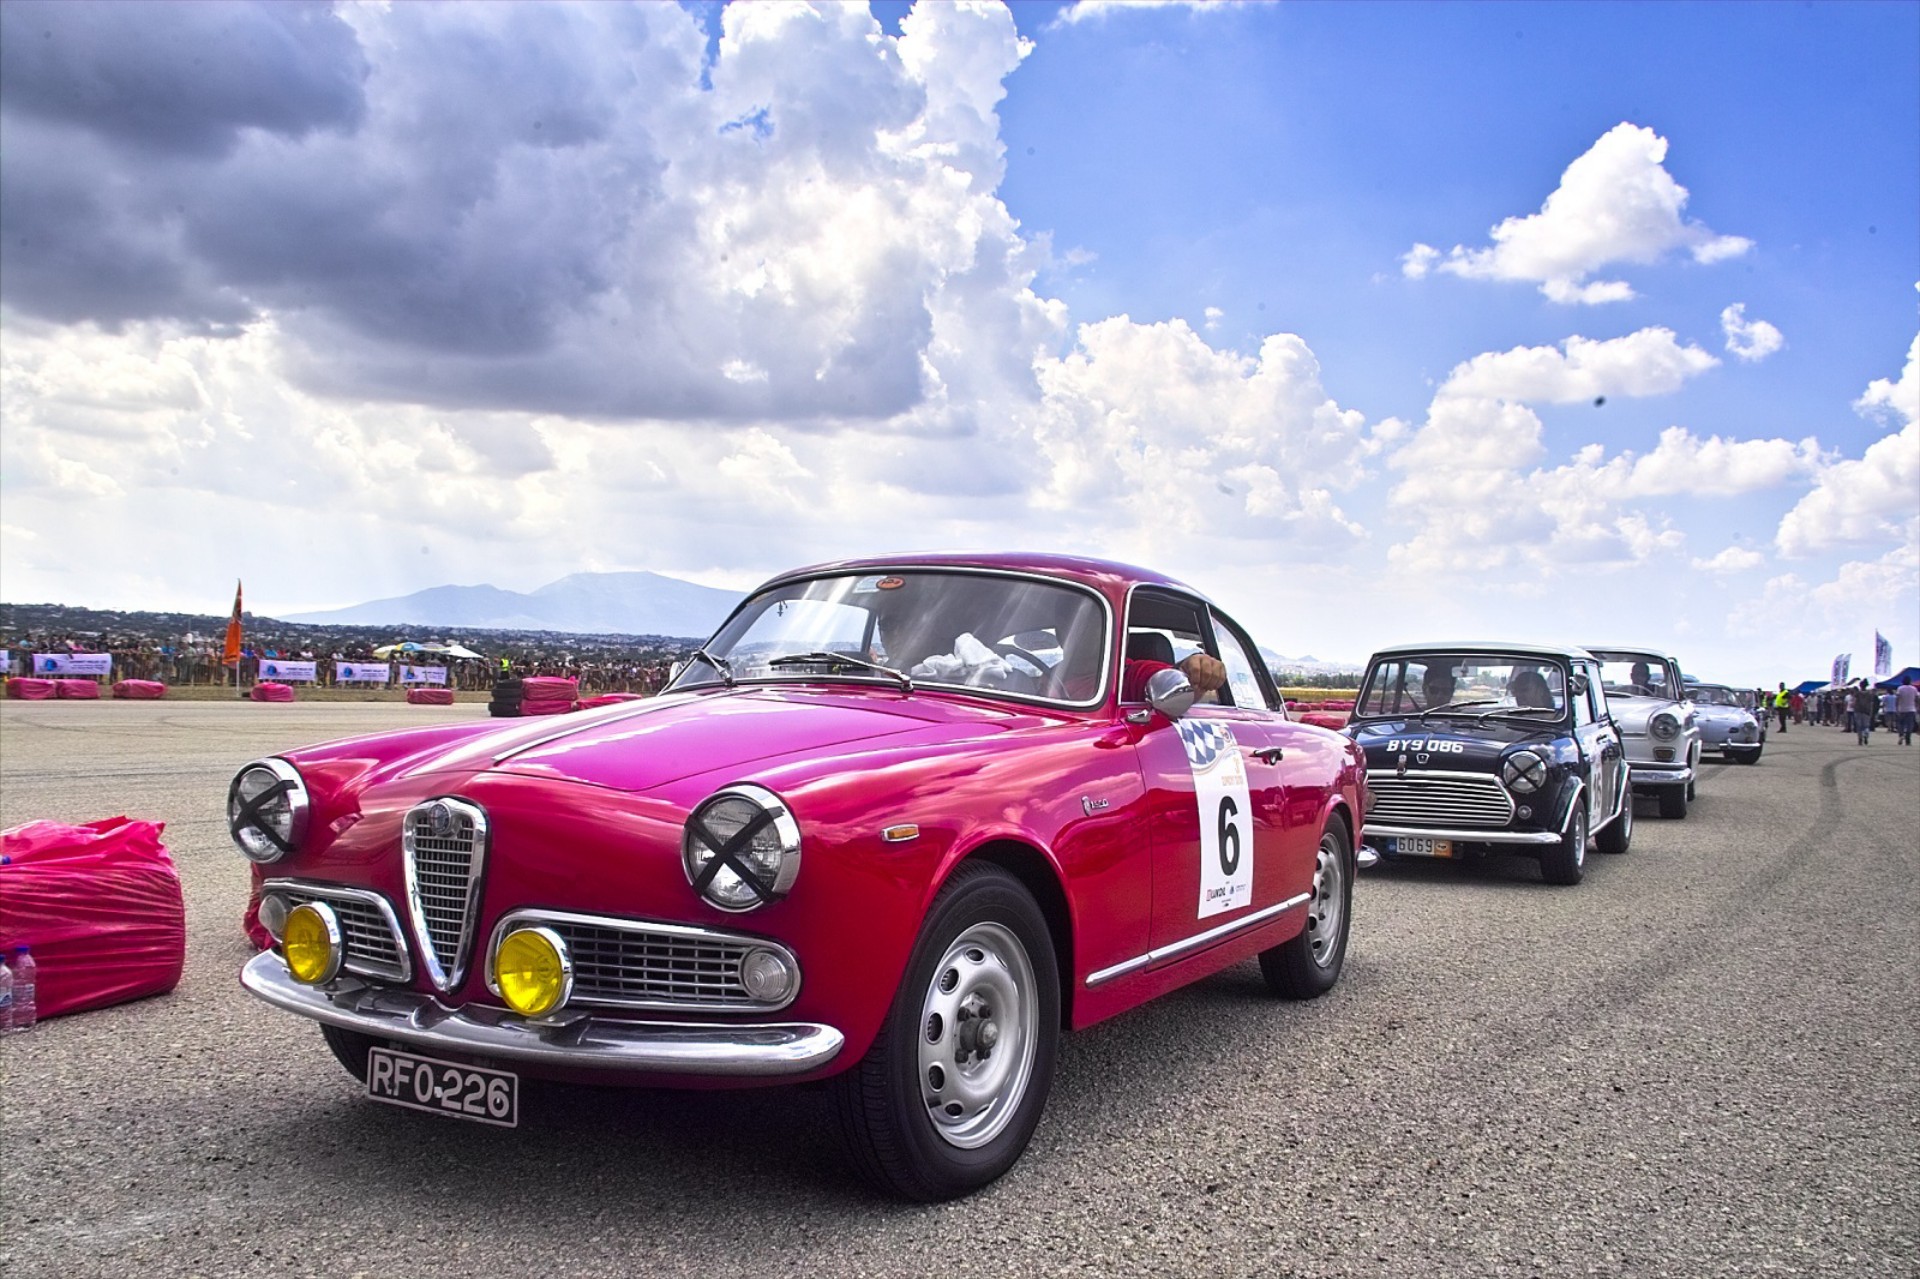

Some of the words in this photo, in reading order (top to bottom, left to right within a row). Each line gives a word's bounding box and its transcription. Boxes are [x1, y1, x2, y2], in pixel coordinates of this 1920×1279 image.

[1426, 739, 1464, 753] 086
[1218, 795, 1240, 876] 6
[1399, 837, 1433, 852] 6069
[441, 1069, 510, 1118] 226
